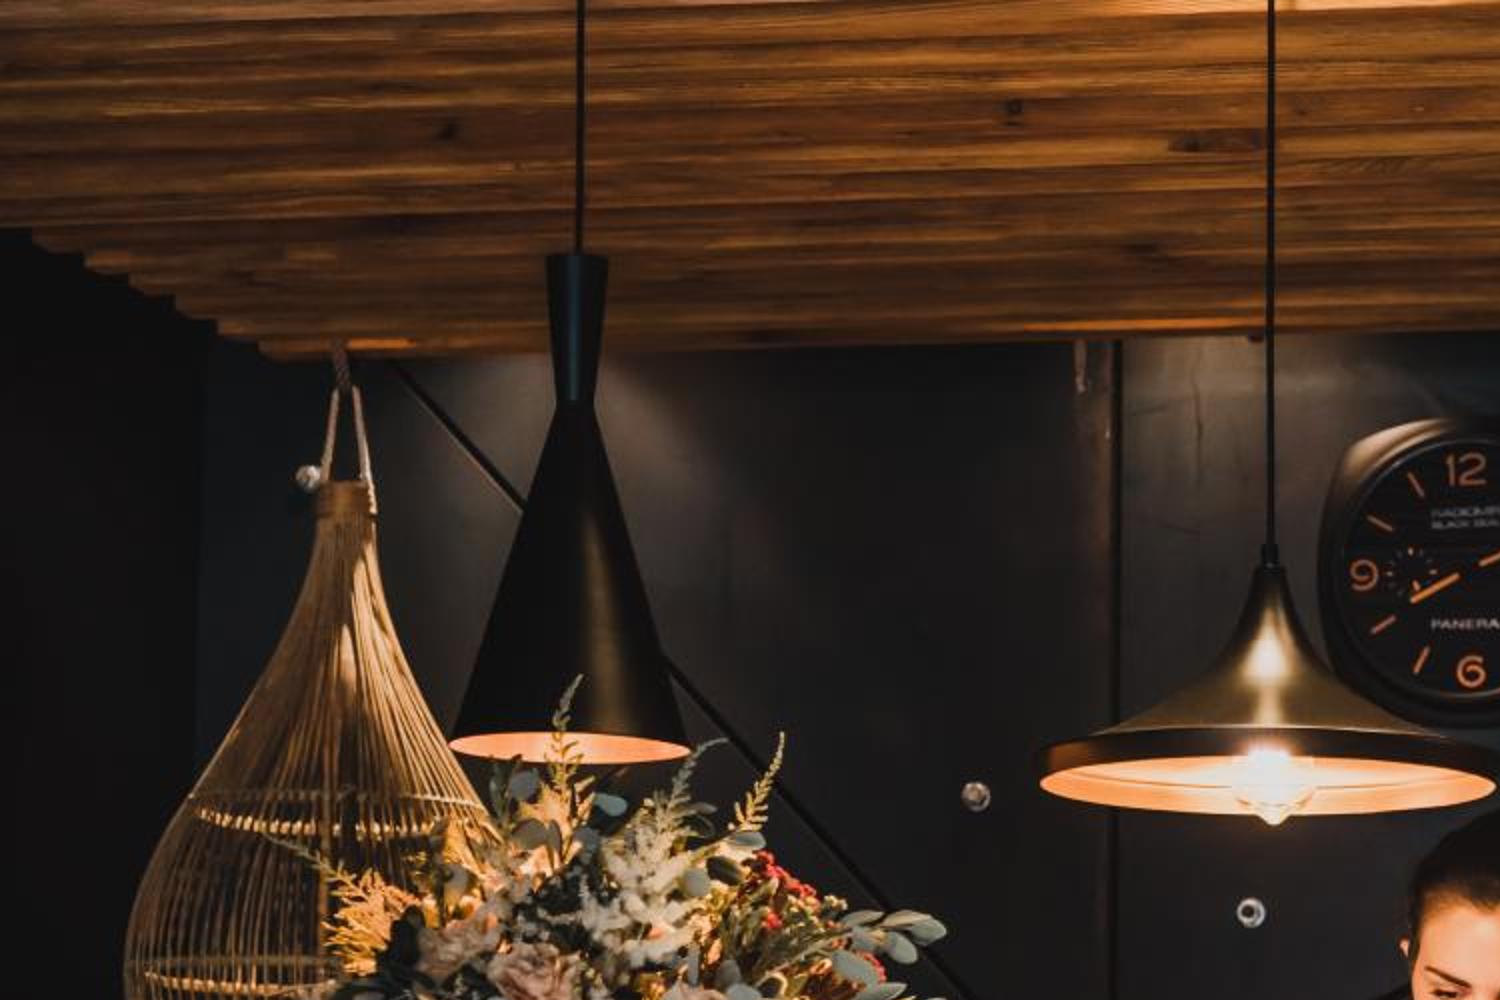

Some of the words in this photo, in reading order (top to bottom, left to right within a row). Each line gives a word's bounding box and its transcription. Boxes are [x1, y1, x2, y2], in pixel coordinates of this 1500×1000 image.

[1446, 452, 1488, 487] 12
[1349, 558, 1379, 591] 9
[1456, 654, 1487, 688] 6
